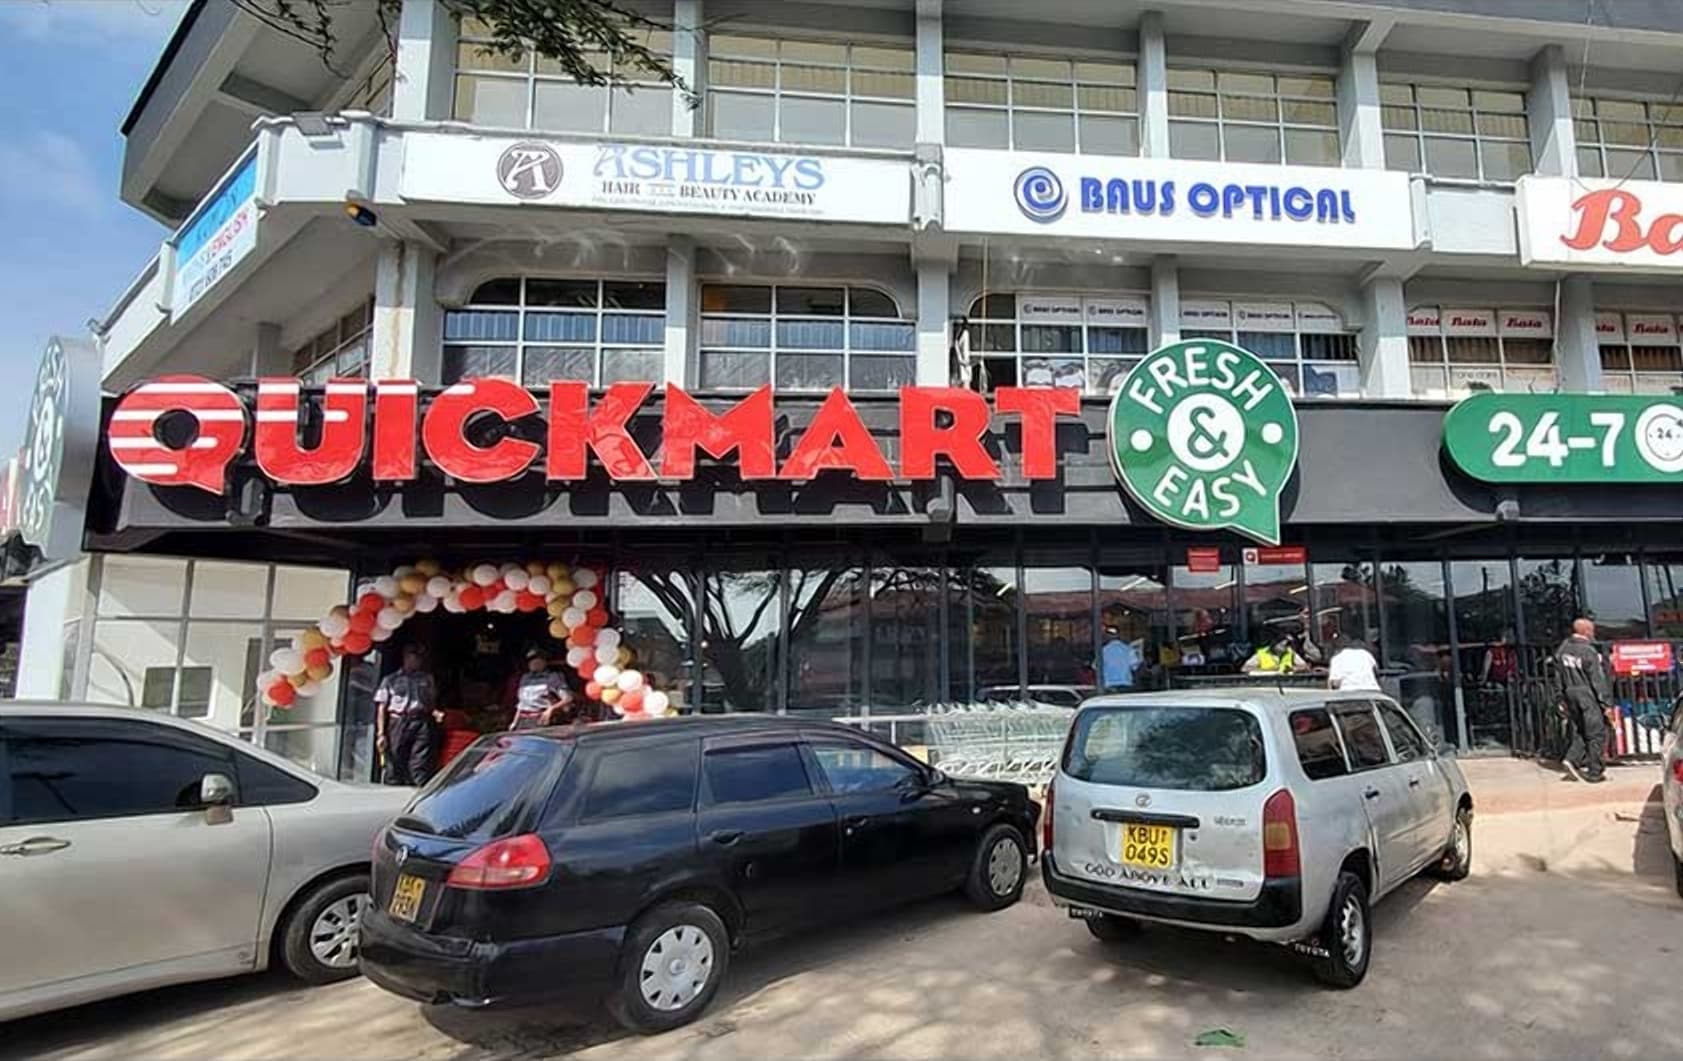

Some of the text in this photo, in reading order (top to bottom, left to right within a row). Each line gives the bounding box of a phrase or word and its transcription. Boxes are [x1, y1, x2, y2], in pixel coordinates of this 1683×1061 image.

[592, 143, 826, 190] ASHLEYS
[601, 180, 641, 196] HAIR
[679, 184, 742, 203] BEAUTY
[742, 190, 817, 206] ACADEMY
[1079, 176, 1357, 224] BAUS OPTICAL
[1128, 346, 1274, 415] FRESH
[108, 375, 1081, 495] QUICKMART
[1186, 405, 1230, 460] &
[1487, 411, 1625, 468] 24-7
[1153, 459, 1267, 520] EASY
[1125, 843, 1169, 866] 049S
[1127, 826, 1160, 846] KBU
